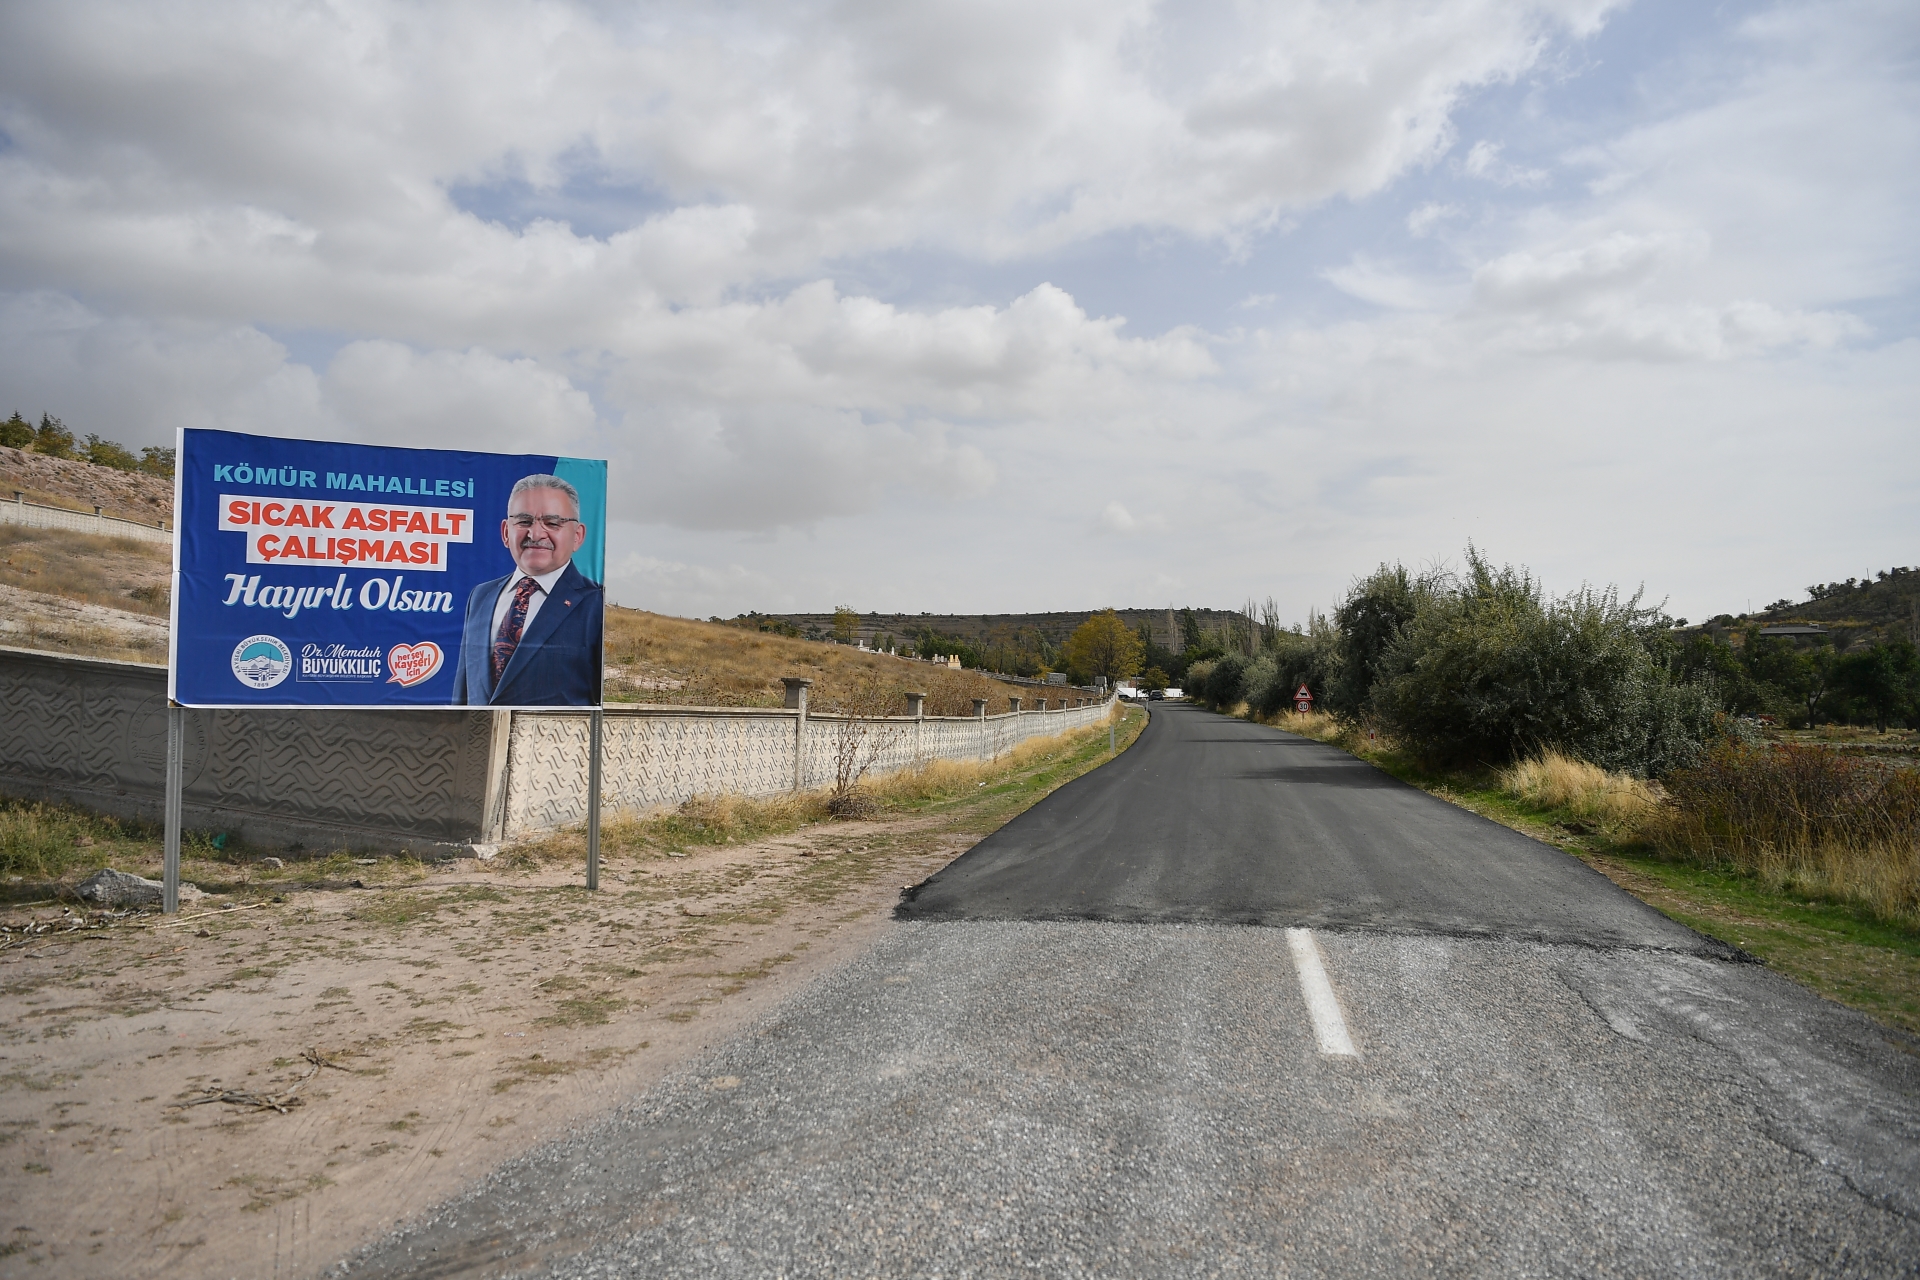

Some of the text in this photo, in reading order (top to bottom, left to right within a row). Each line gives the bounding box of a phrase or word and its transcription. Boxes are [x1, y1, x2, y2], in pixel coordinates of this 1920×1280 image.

[214, 462, 475, 498] KÖMÜR MAHALLESİ
[227, 501, 466, 536] SICAK ASFALT
[256, 534, 439, 565] ÇALIŞMASI
[222, 573, 454, 619] Hayırlı Olsun
[301, 643, 382, 658] Dr. Memduh
[397, 653, 411, 662] her
